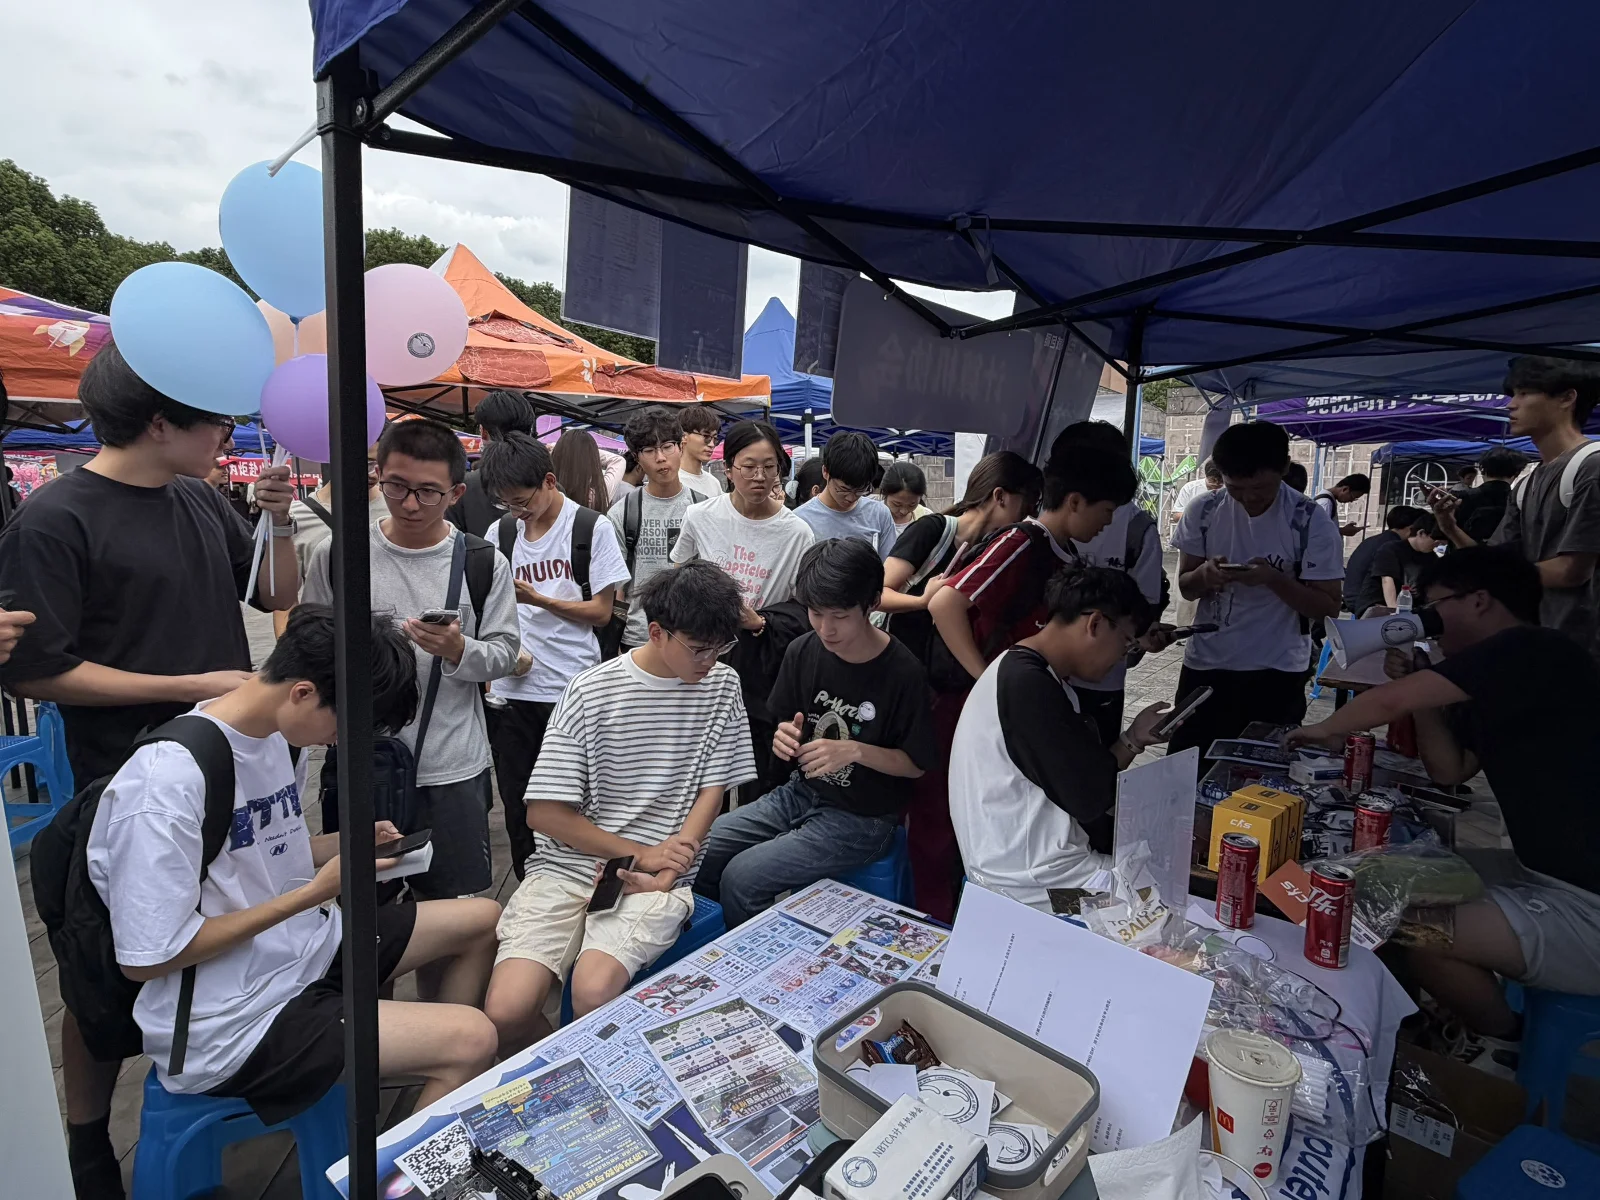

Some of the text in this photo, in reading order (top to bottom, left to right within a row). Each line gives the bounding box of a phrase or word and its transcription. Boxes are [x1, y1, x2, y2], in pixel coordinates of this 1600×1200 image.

[640, 519, 661, 528] VER
[733, 544, 756, 563] The
[735, 1091, 793, 1118] MINECRAFT
